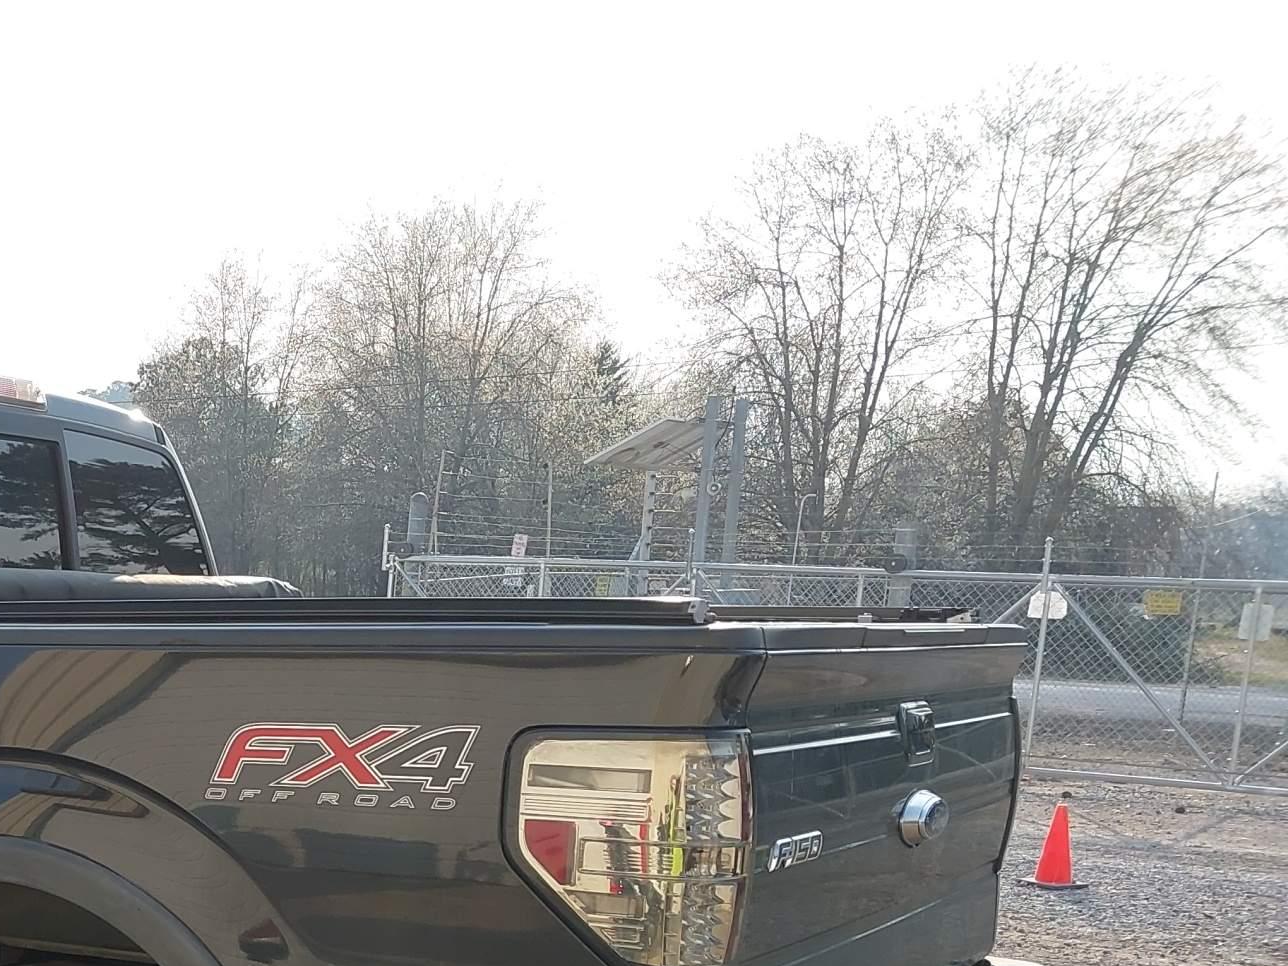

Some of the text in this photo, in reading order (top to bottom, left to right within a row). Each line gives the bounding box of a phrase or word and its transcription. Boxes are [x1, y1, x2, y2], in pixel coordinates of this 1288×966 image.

[210, 722, 481, 793] FX4
[204, 787, 456, 810] OFF ROAD
